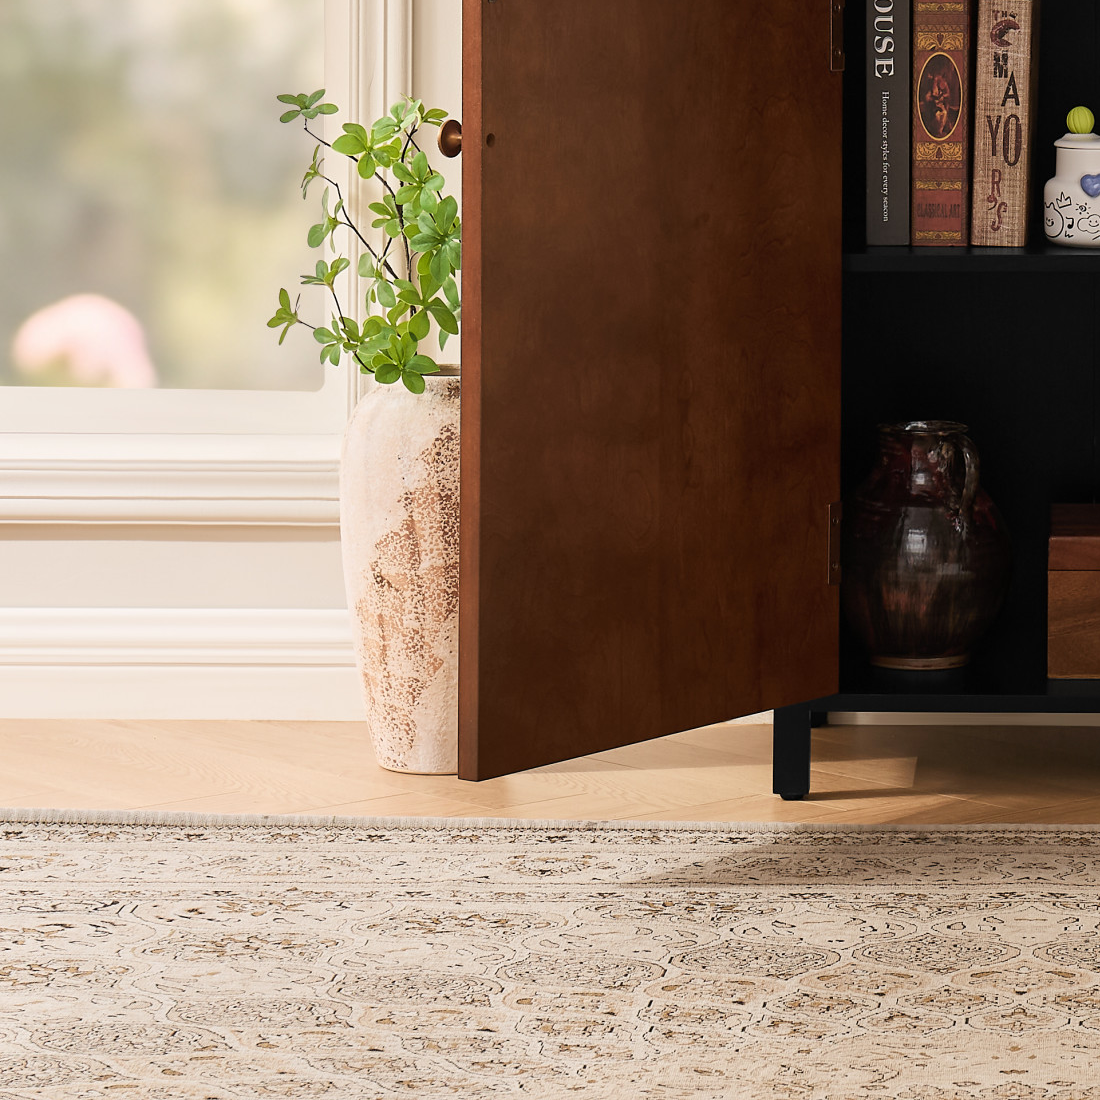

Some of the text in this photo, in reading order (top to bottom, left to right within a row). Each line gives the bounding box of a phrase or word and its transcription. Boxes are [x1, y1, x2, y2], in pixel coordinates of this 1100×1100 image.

[881, 91, 890, 116] Home
[882, 117, 890, 139] decor
[880, 140, 890, 161] styles
[882, 162, 891, 174] for
[880, 175, 888, 195] every
